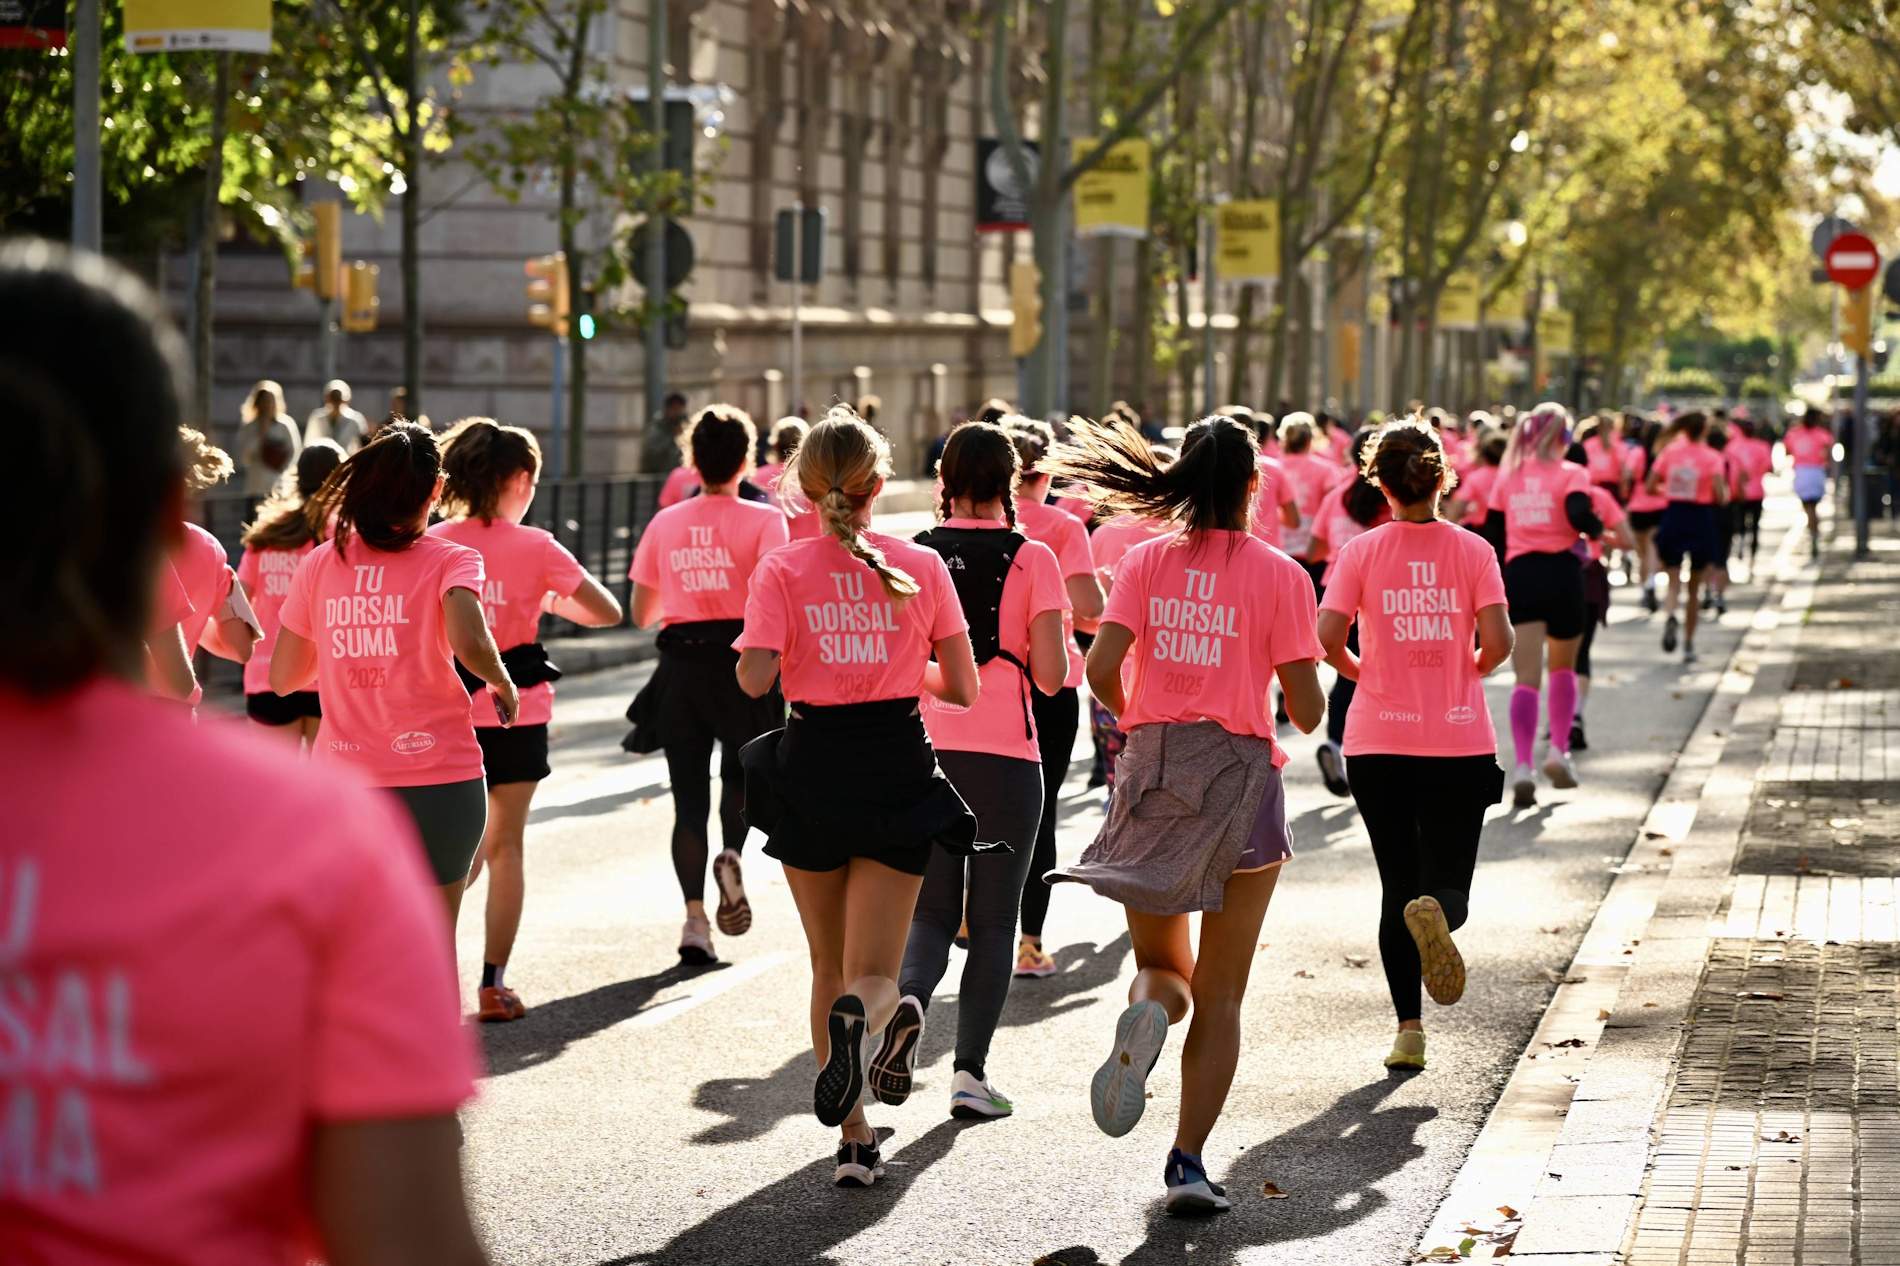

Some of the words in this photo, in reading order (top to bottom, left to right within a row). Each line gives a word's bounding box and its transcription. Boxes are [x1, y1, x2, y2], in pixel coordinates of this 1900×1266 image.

[688, 525, 713, 547] TU
[259, 550, 299, 575] DORS
[669, 545, 736, 573] DORSAL
[264, 574, 292, 597] SU
[354, 564, 385, 593] TU
[680, 568, 730, 592] SUMA
[829, 571, 865, 601] TU
[1184, 567, 1217, 602] TU
[1407, 560, 1437, 587] TU
[325, 594, 409, 629] DORSAL
[1382, 587, 1462, 615] DORSAL
[804, 601, 900, 634] DORSAL
[1149, 596, 1240, 638] DORSAL
[1393, 615, 1454, 642] SUMA
[331, 626, 399, 659] SUMA
[819, 633, 889, 665] SUMA
[1153, 629, 1222, 668] SUMA
[1408, 650, 1445, 668] 2025
[349, 667, 387, 689] 2025
[1163, 671, 1205, 697] 2025
[1379, 709, 1422, 723] OYSHO
[328, 738, 361, 753] SHO
